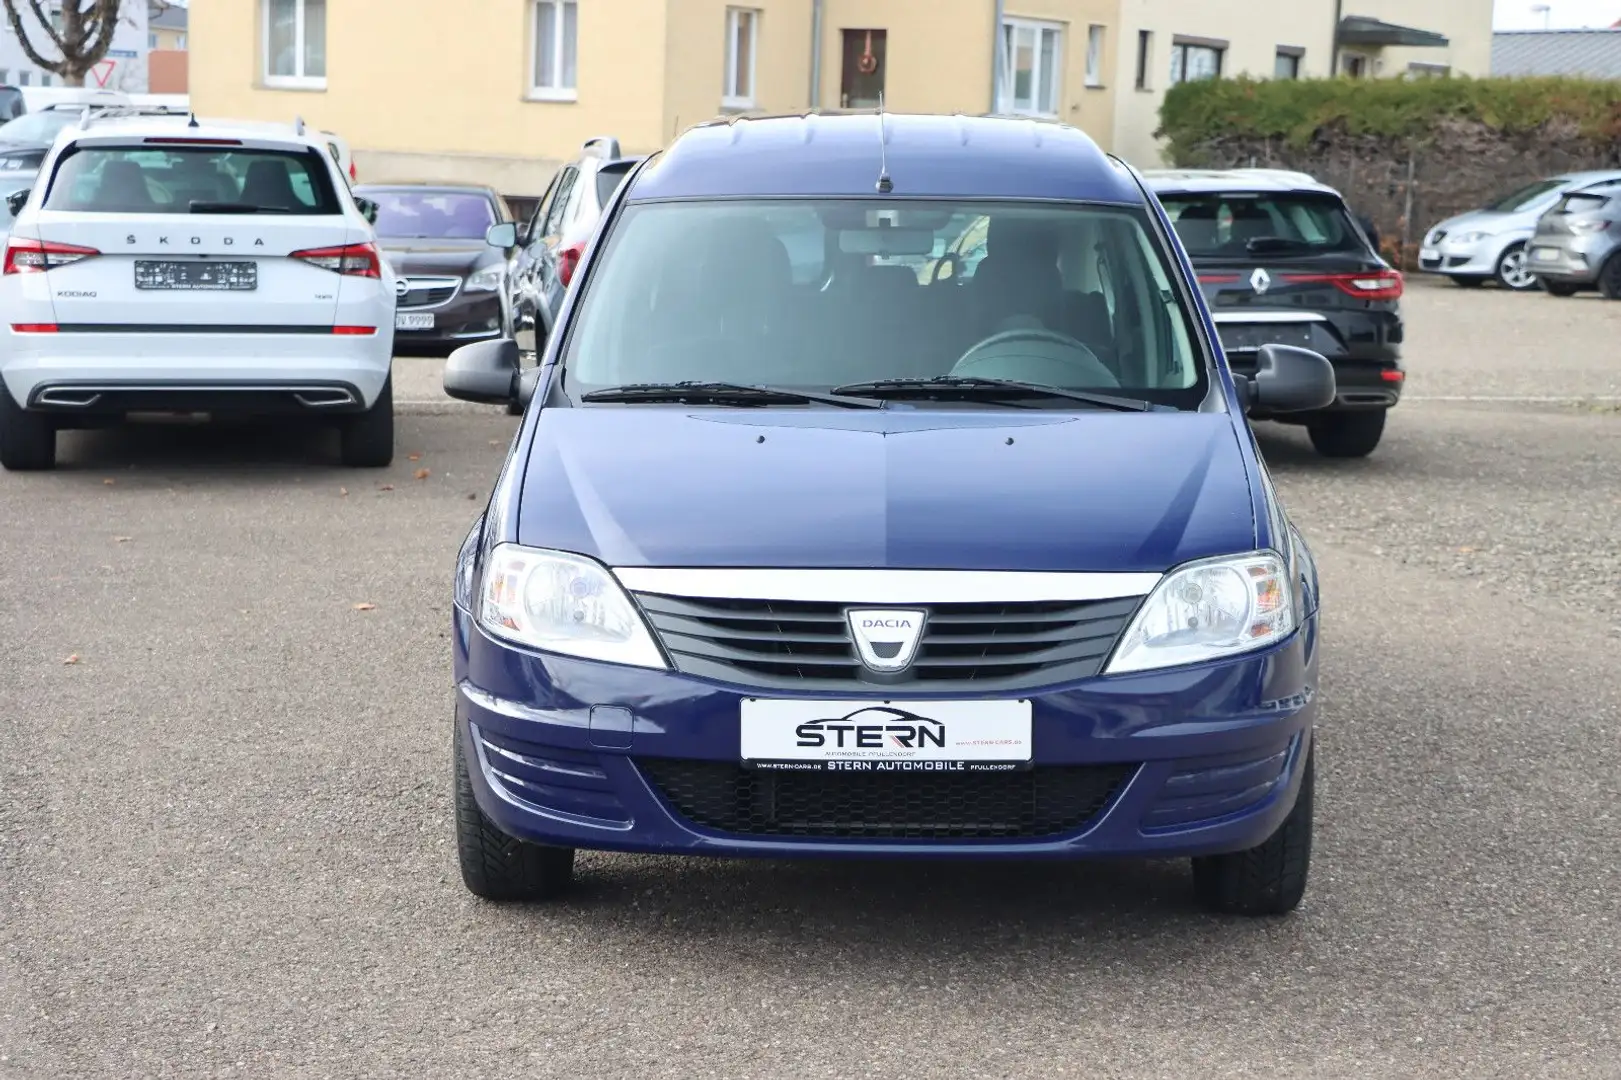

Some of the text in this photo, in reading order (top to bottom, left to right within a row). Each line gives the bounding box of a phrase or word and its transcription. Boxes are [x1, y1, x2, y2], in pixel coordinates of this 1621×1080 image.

[862, 619, 911, 628] DACIA
[795, 724, 945, 748] STERN
[827, 761, 872, 770] STERN
[876, 761, 965, 770] AUTOMOBILE
